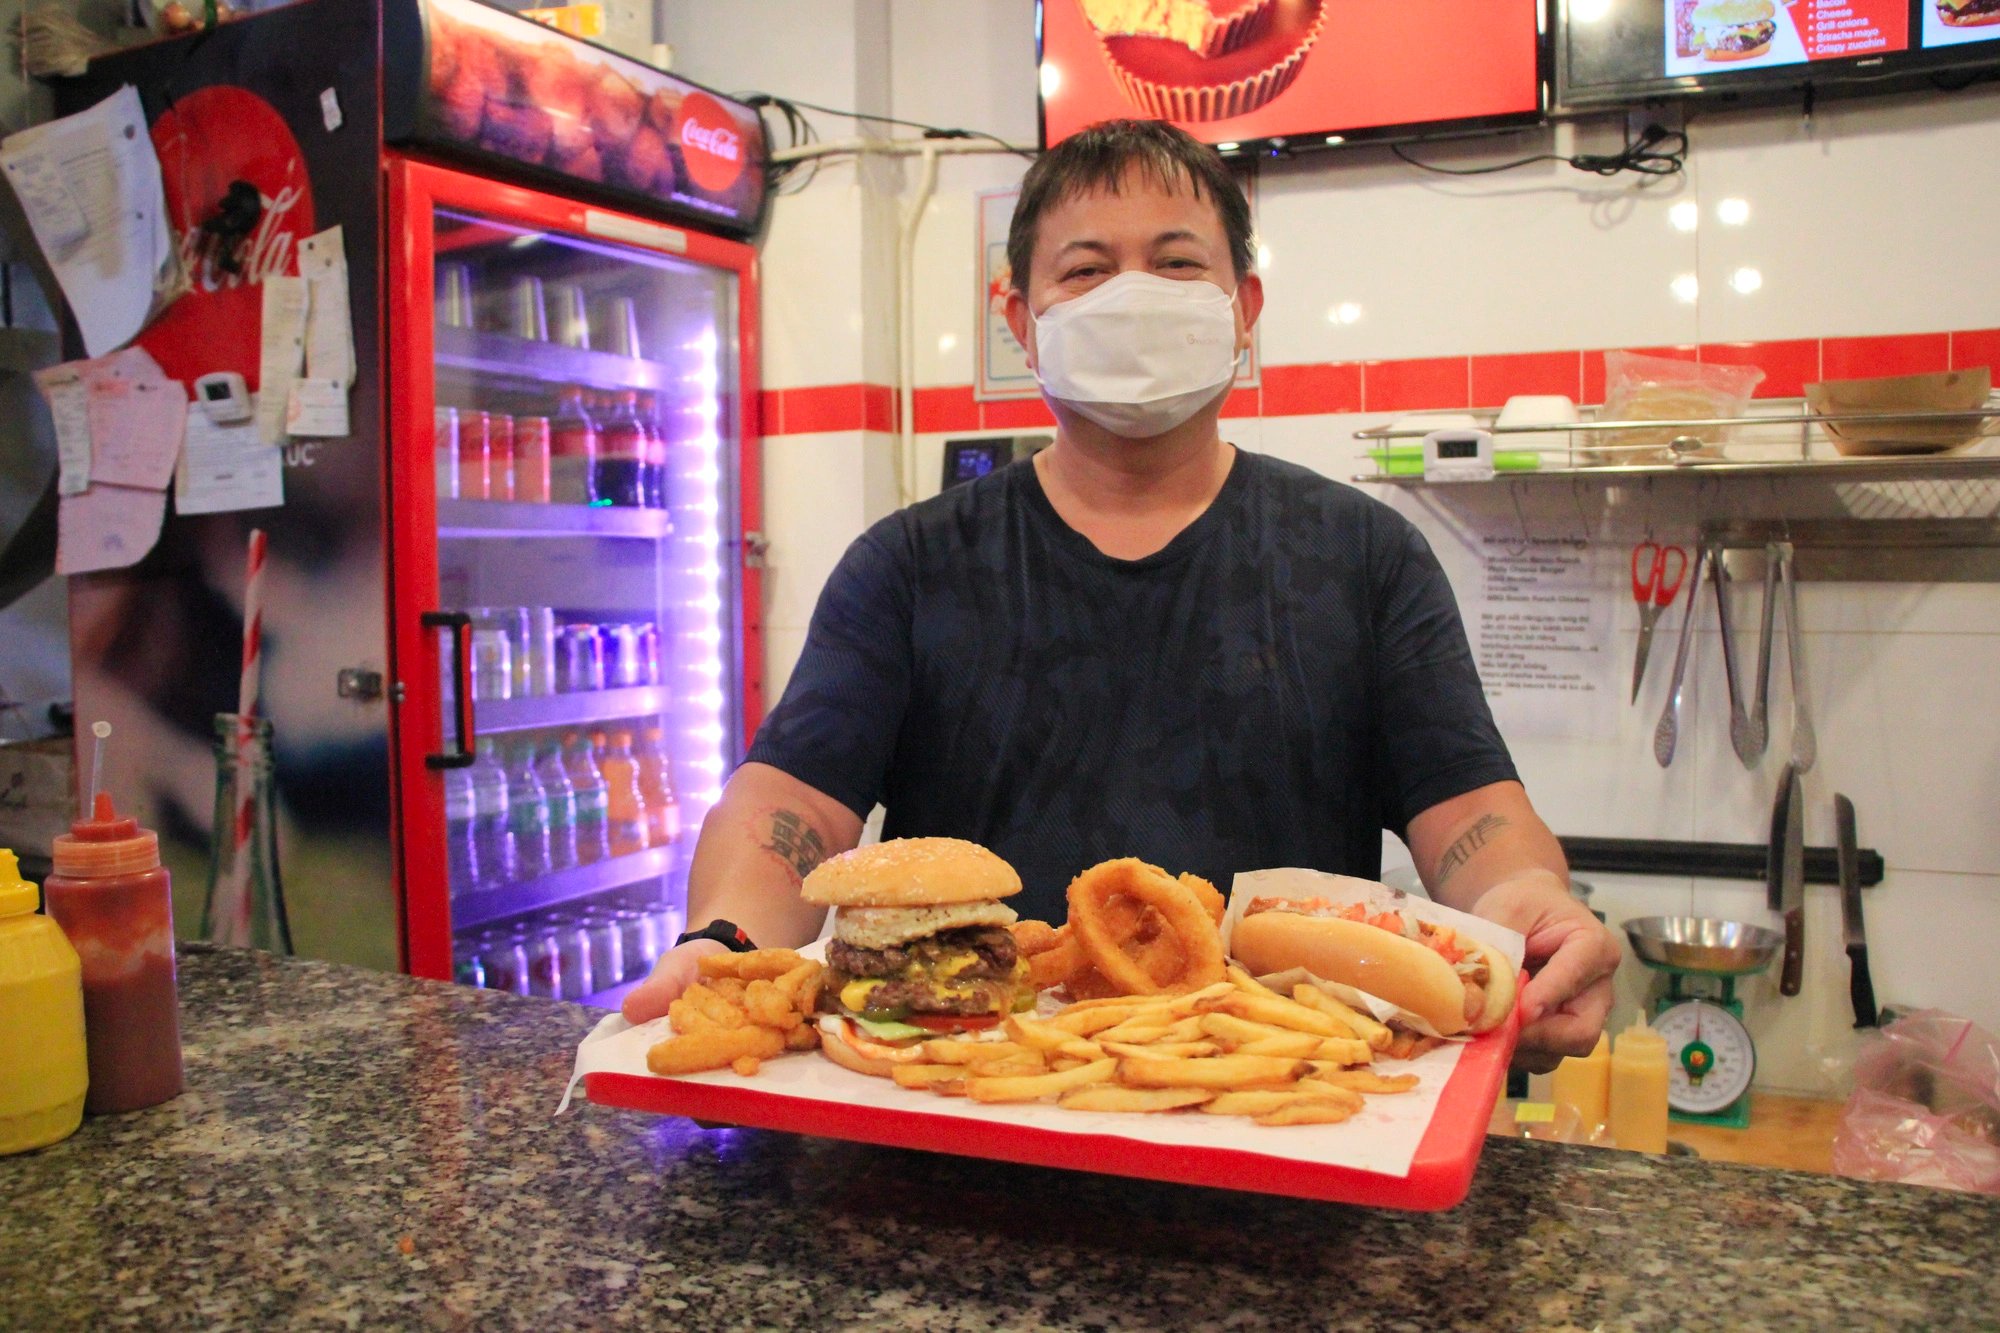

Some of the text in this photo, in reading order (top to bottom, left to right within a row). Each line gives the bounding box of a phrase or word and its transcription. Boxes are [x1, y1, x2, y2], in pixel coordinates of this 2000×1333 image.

[1816, 0, 1847, 8] Bacon
[1816, 8, 1853, 19] Cheese
[1816, 17, 1869, 31] Grill onions
[1854, 27, 1880, 38] mayo
[1816, 37, 1886, 54] Crispy zucchini
[681, 116, 739, 161] Coca-Cola
